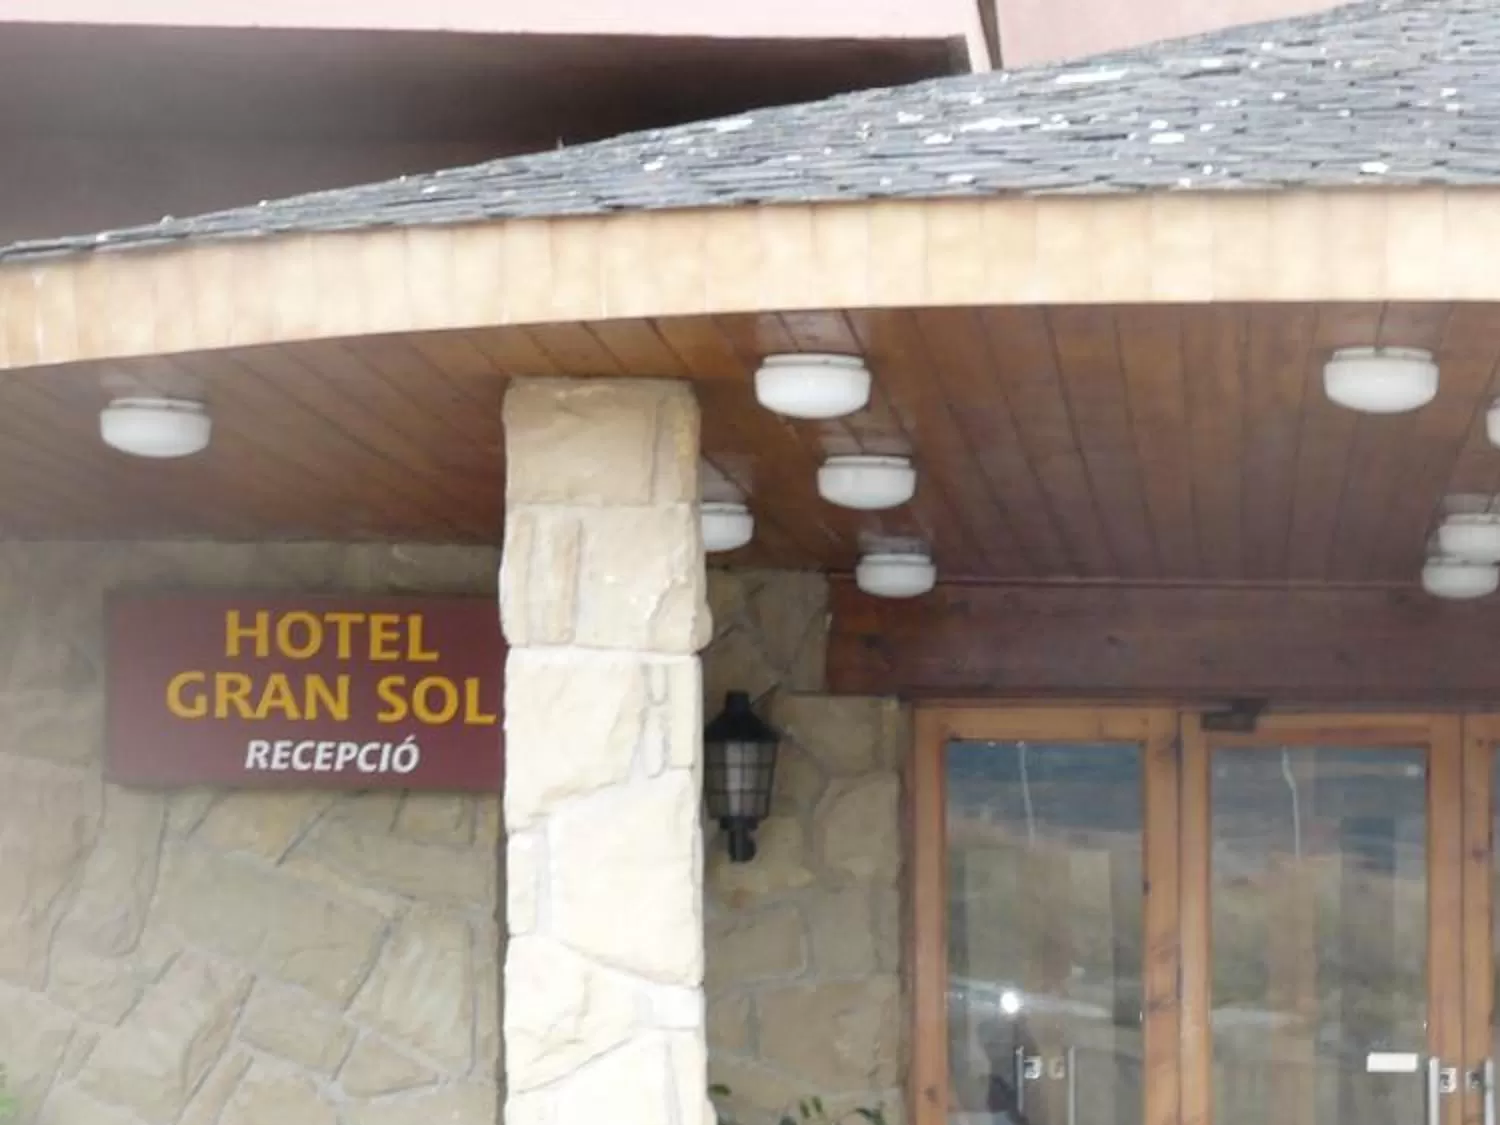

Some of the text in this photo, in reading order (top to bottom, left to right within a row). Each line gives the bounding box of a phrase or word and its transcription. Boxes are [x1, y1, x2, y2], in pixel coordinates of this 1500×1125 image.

[224, 610, 439, 662] HOTEL
[166, 671, 496, 726] GRAN SOL
[245, 734, 421, 774] RECEPCIÓ
